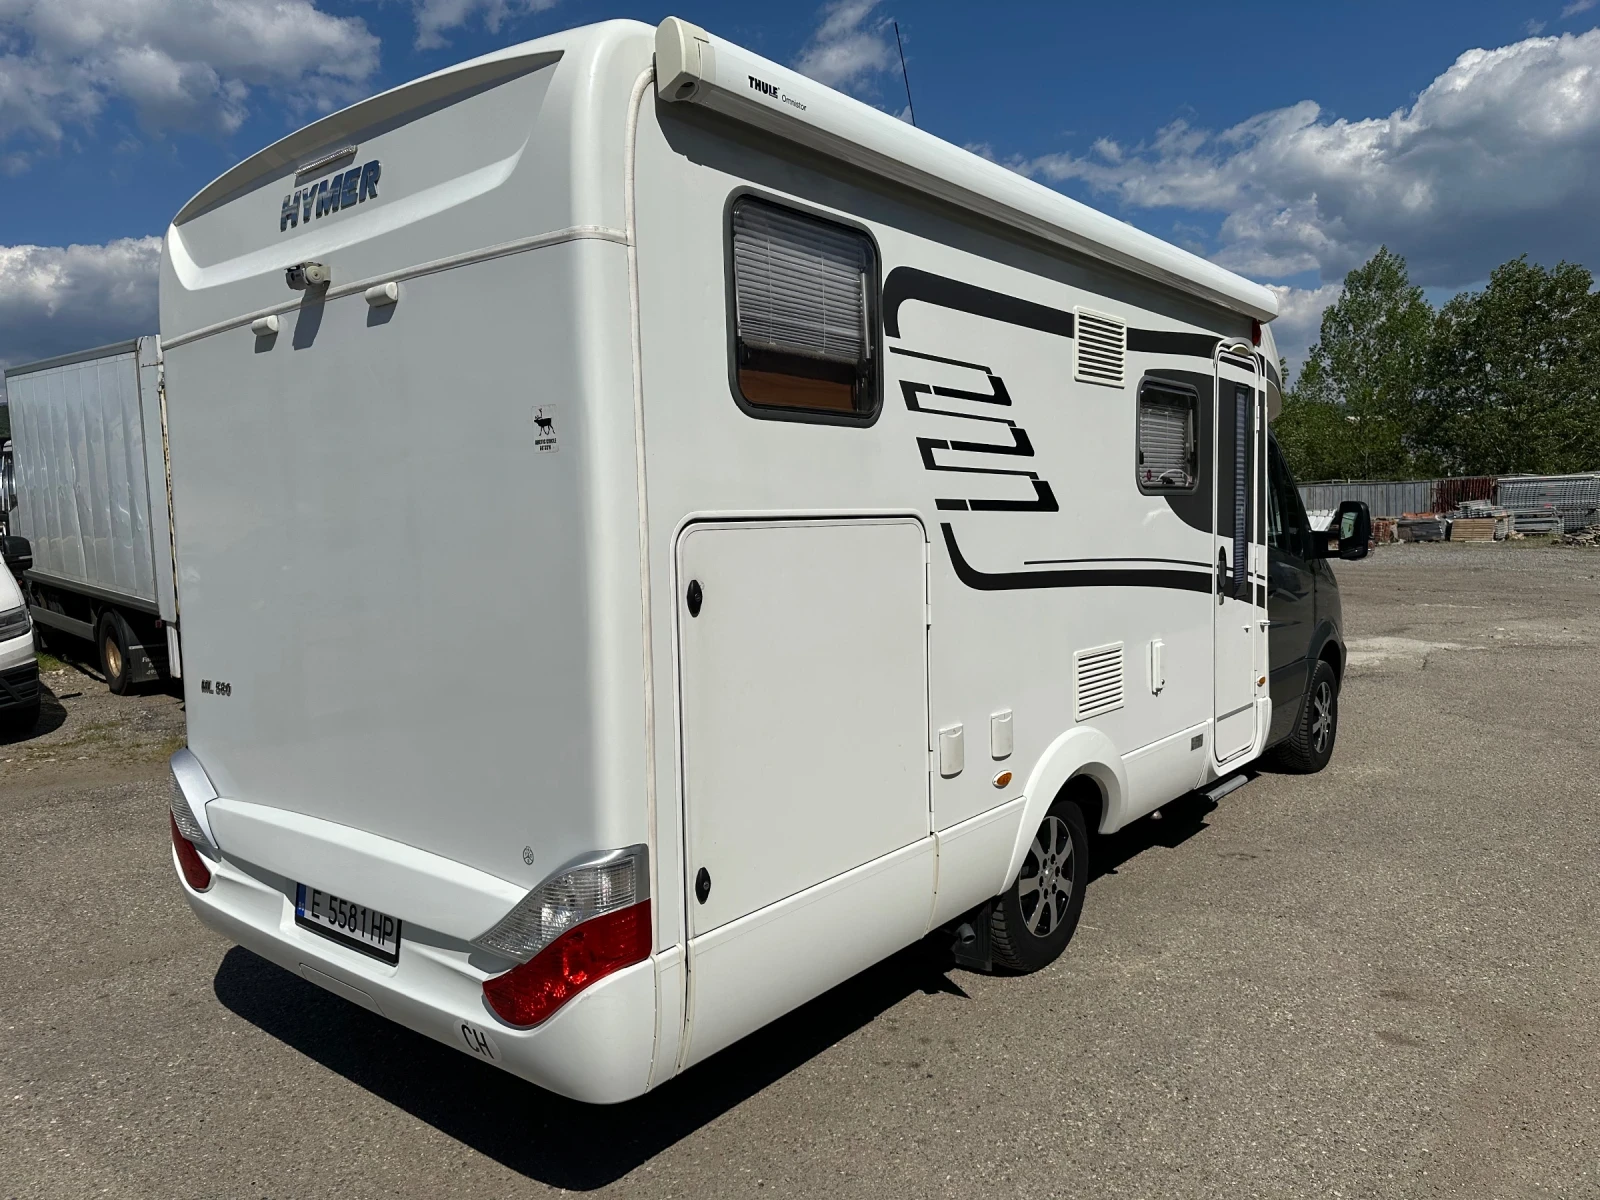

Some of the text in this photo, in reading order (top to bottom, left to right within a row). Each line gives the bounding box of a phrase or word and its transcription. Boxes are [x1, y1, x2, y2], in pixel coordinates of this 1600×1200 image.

[748, 75, 779, 99] THULE
[280, 160, 381, 232] HYMER
[311, 888, 322, 920] E
[461, 1024, 495, 1059] CH
